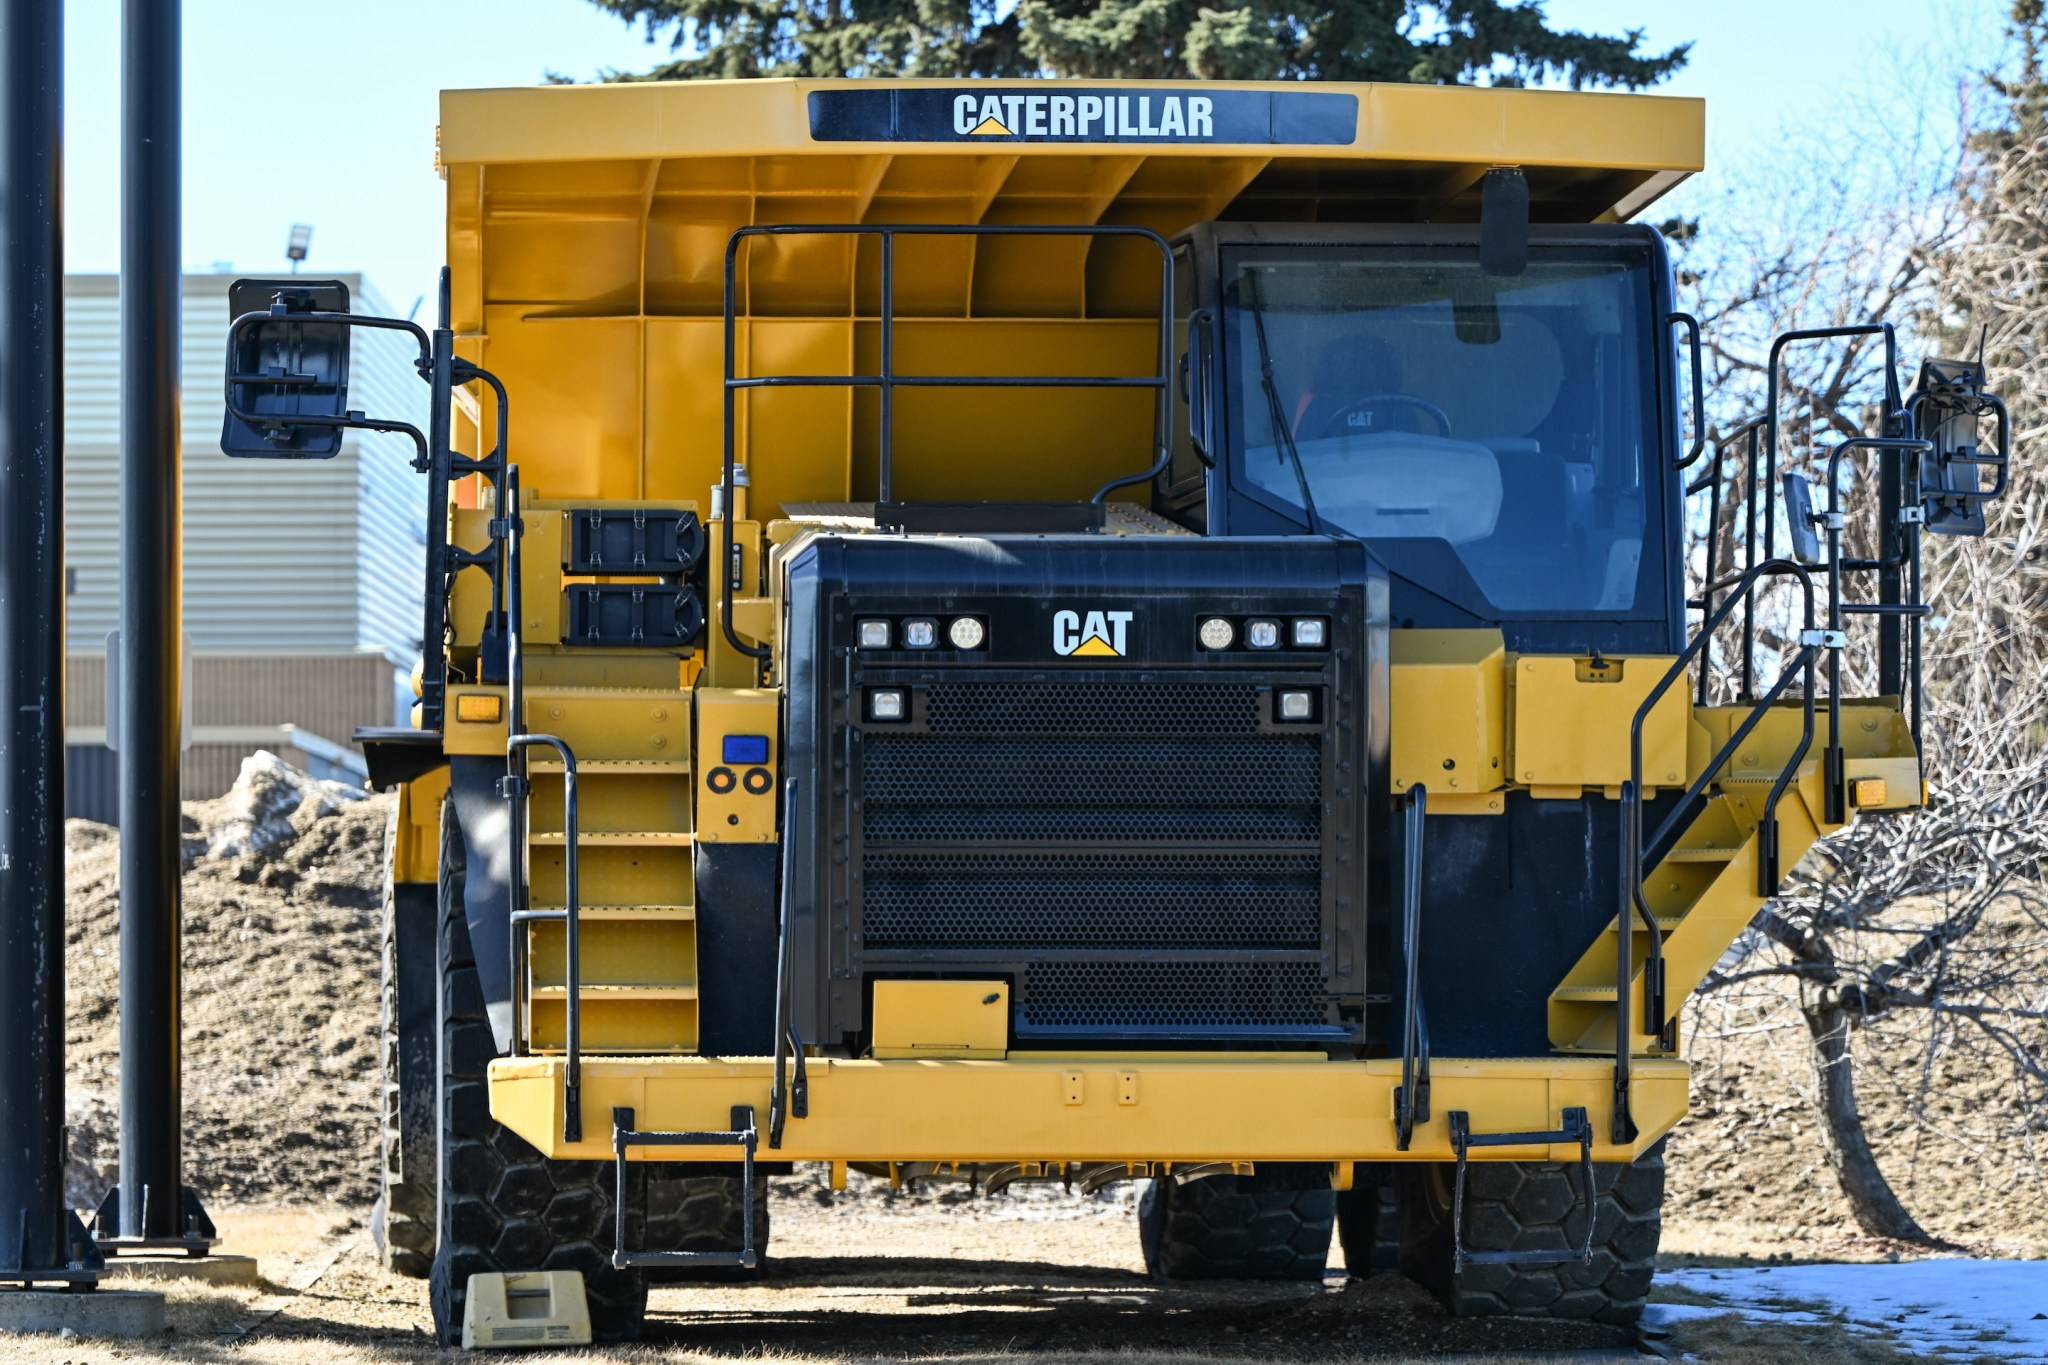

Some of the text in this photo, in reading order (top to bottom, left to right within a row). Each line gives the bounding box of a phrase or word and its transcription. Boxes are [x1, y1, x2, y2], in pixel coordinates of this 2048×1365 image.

[953, 94, 1213, 136] CATERPILLAR
[1347, 411, 1374, 426] CAT
[1053, 610, 1133, 656] CAT
